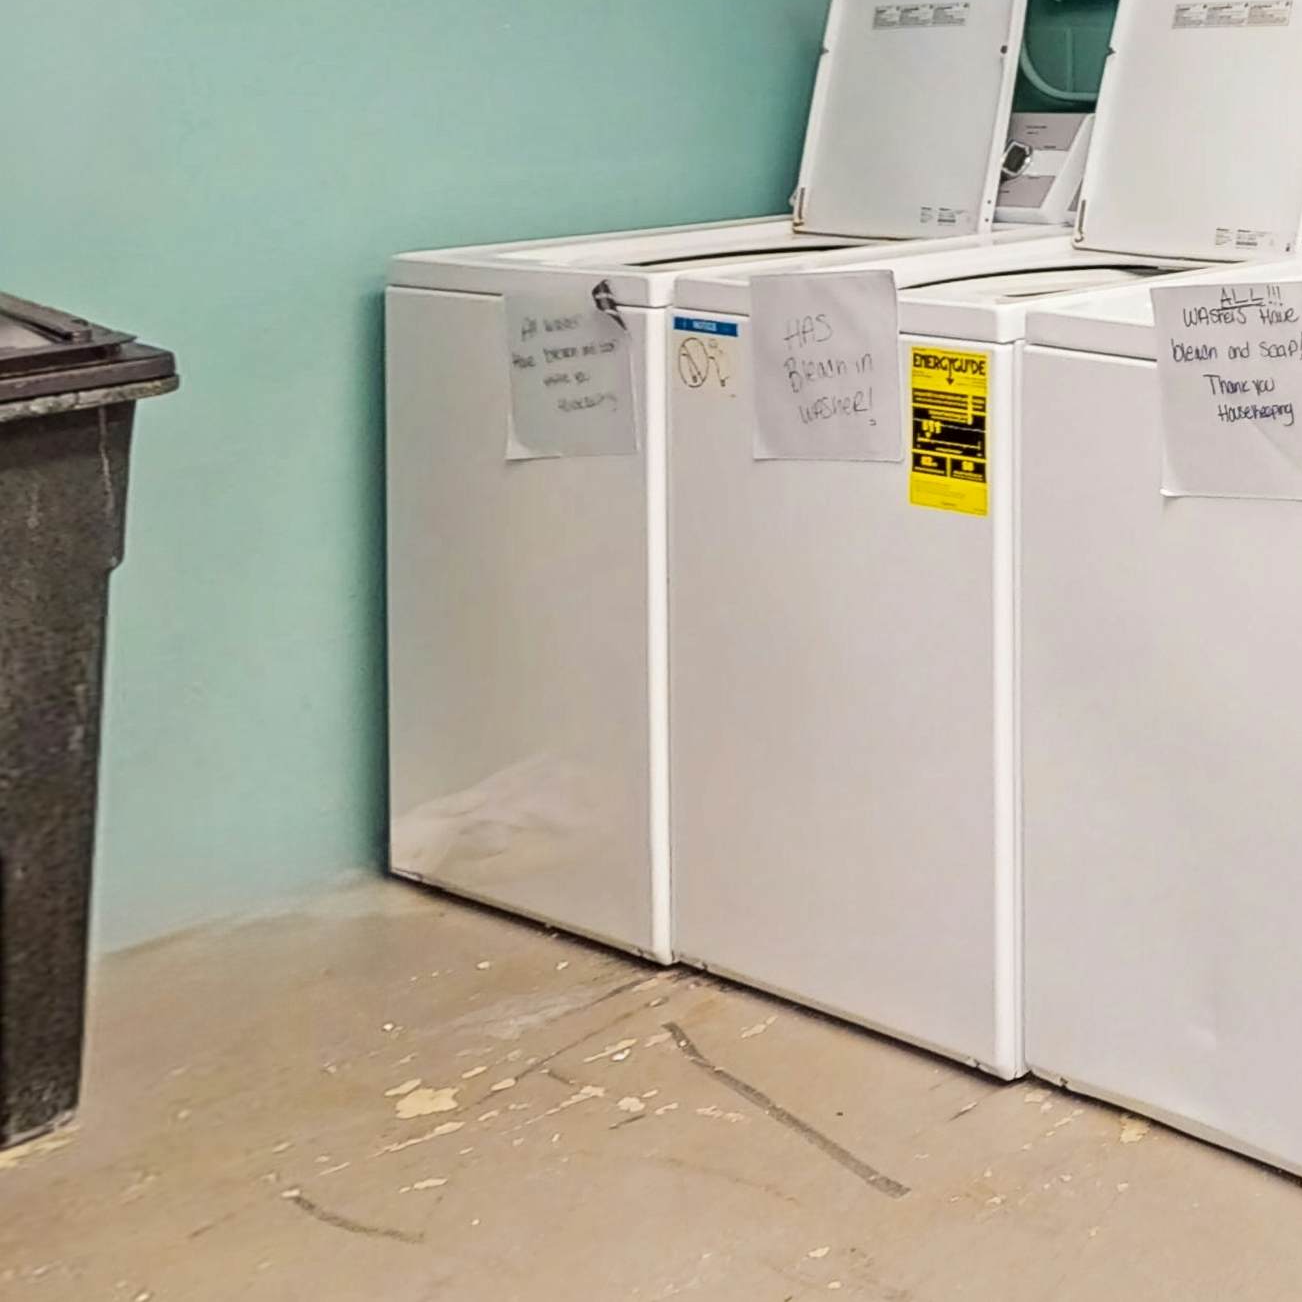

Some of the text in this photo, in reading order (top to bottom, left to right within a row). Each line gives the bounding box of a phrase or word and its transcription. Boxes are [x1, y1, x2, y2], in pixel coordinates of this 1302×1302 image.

[784, 314, 833, 350] HAS
[1228, 341, 1250, 360] and
[856, 353, 873, 374] in
[1203, 374, 1250, 395] Thank
